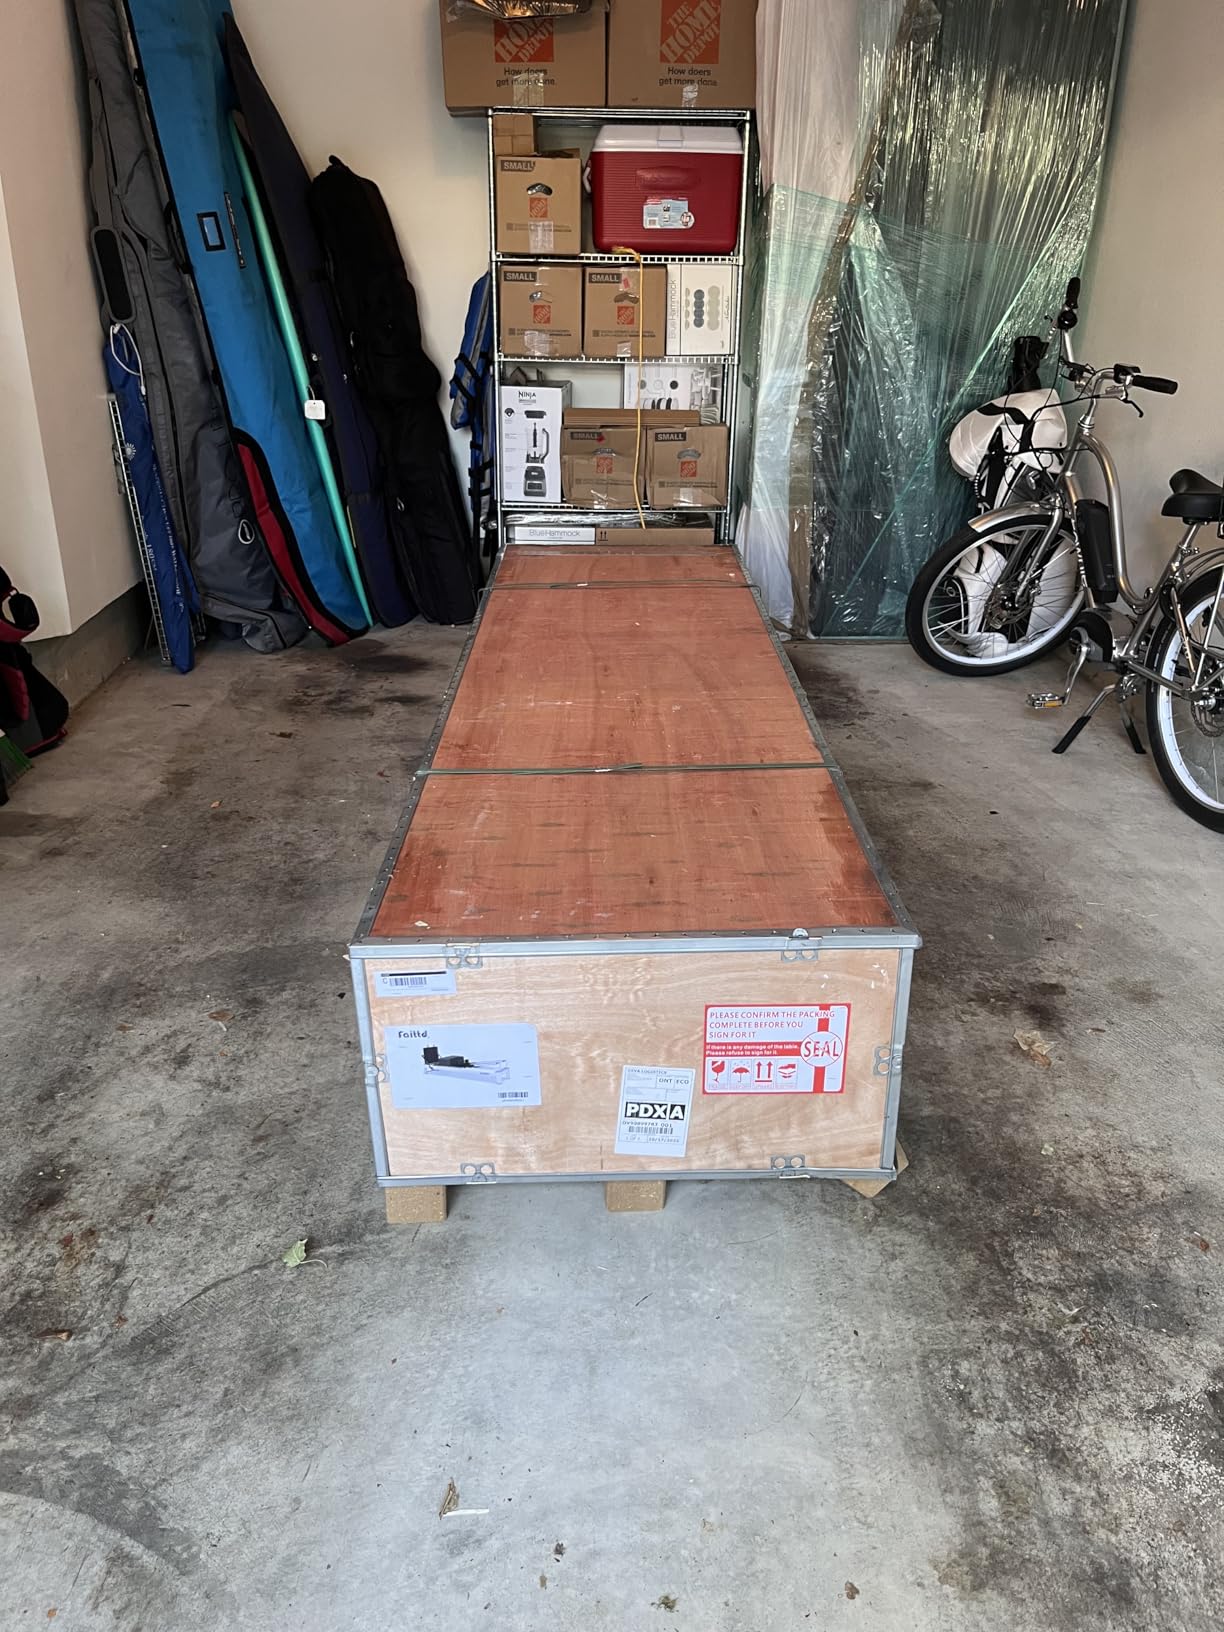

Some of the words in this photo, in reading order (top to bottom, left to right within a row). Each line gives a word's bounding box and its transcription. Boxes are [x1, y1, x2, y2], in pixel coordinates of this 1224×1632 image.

[666, 1, 691, 29] THE
[683, 21, 720, 63] DEPOT
[503, 67, 521, 76] How
[524, 67, 548, 76] doers
[667, 67, 686, 76] How
[688, 67, 711, 76] doers
[496, 79, 509, 87] get
[658, 78, 672, 86] get
[504, 161, 532, 170] SMALL
[506, 272, 534, 280] SMALL
[591, 274, 619, 282] SMALL
[518, 390, 536, 400] NINJA
[799, 1010, 835, 1018] PACKING
[803, 1040, 839, 1058] SEAL
[626, 1103, 667, 1119] PDX
[669, 1105, 684, 1119] A
